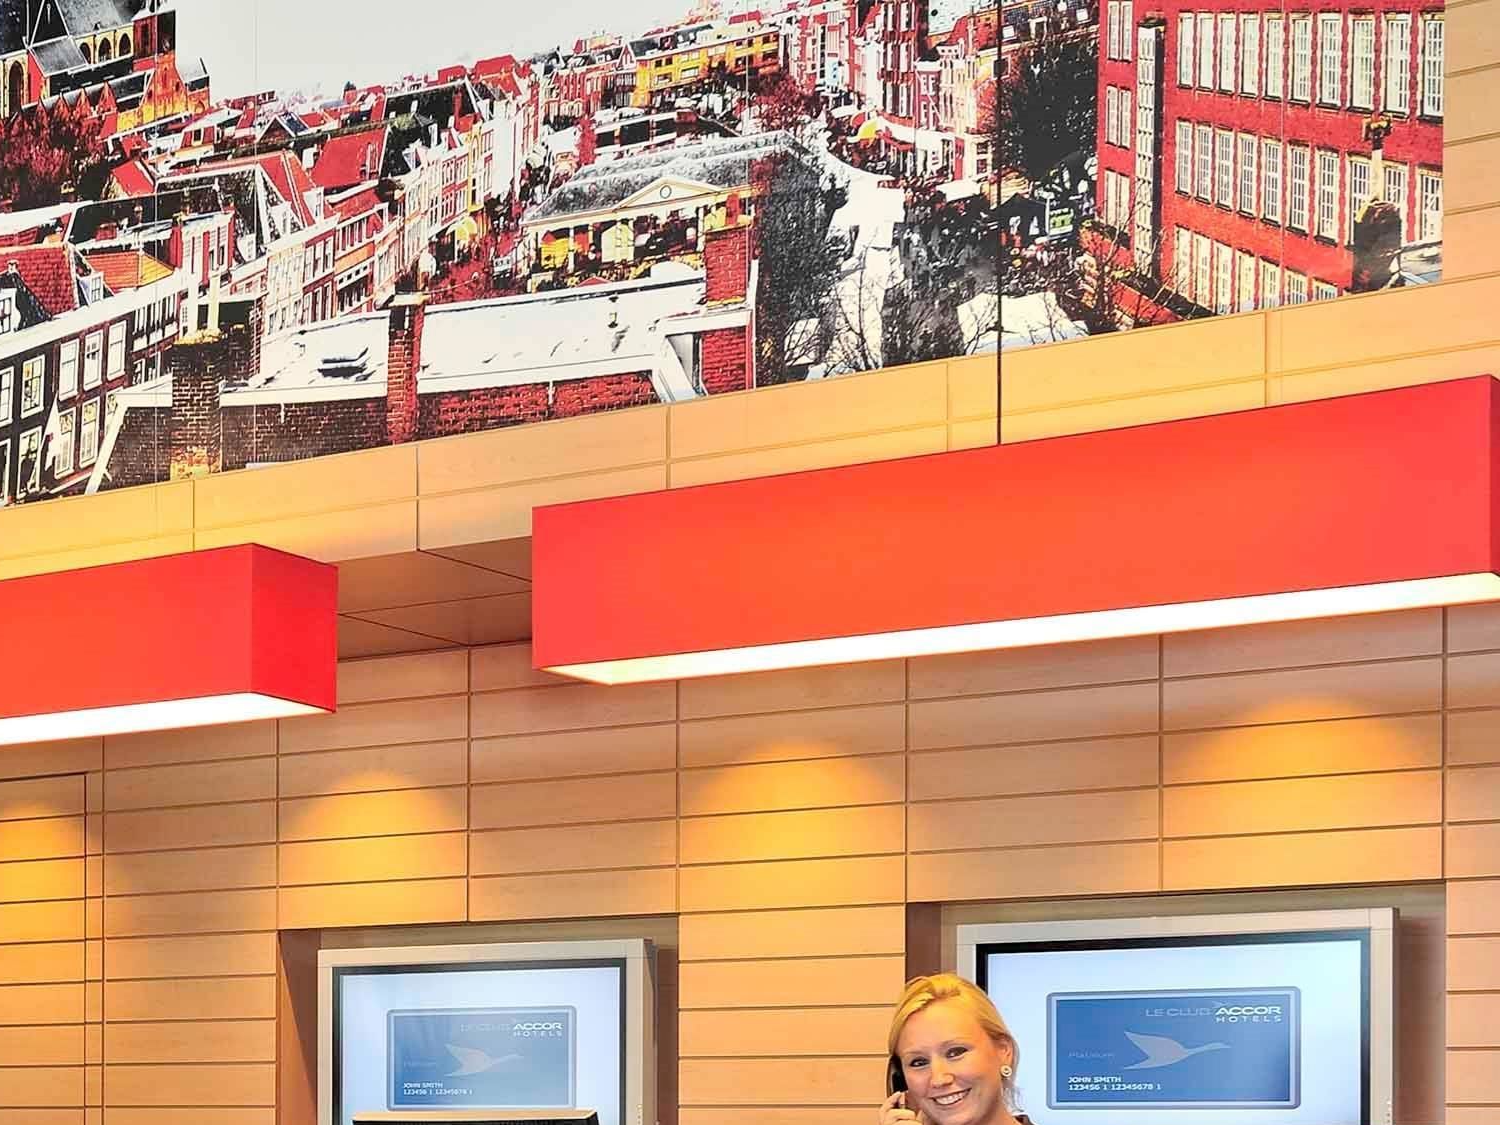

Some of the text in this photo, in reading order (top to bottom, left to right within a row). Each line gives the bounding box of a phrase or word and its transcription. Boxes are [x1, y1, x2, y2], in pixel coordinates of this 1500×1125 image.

[1215, 1006, 1282, 1015] ACCOR
[1216, 1015, 1282, 1024] HOTELS
[513, 1022, 564, 1031] ACCOR
[513, 1030, 563, 1038] HOTELS
